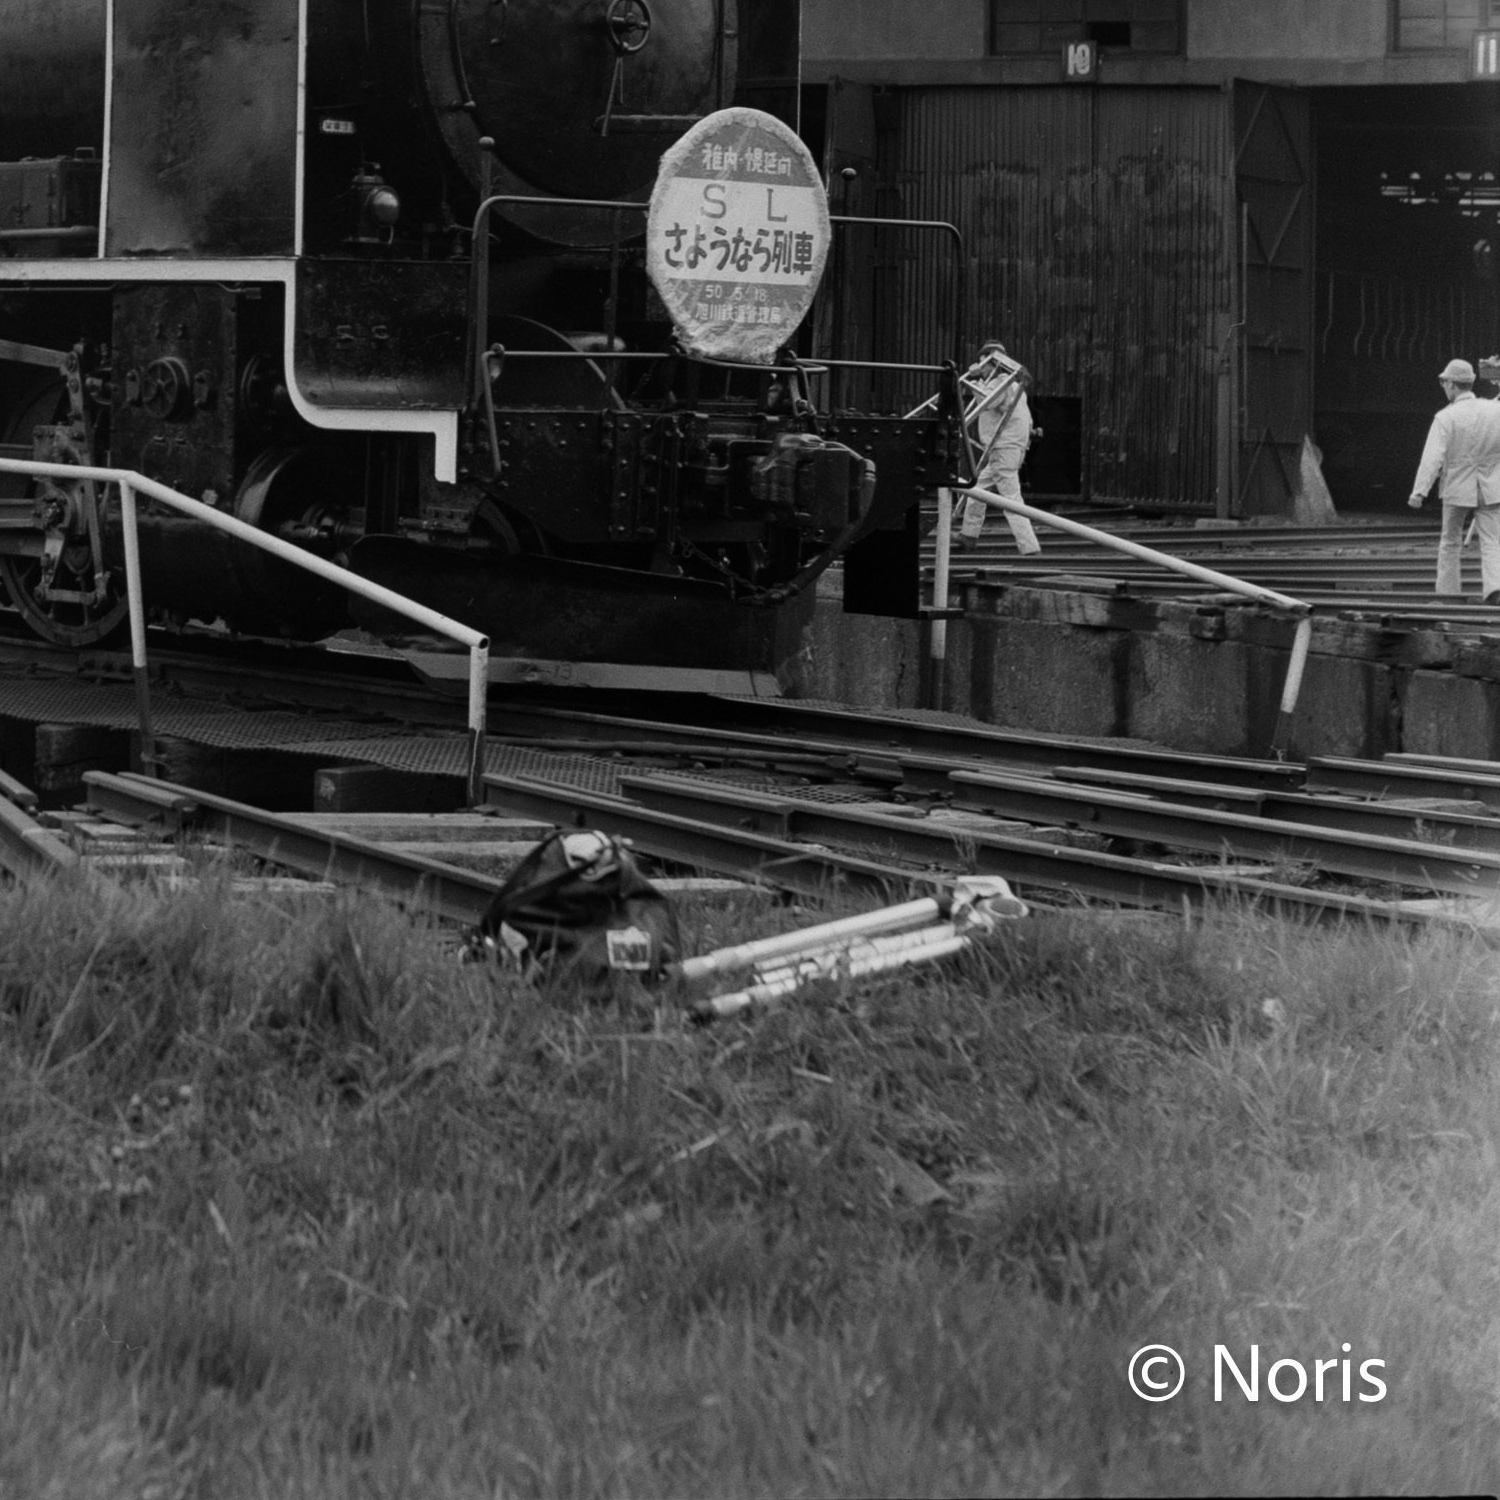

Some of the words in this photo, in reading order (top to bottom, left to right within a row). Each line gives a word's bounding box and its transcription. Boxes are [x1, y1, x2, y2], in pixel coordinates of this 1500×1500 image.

[1477, 38, 1497, 73] 11
[701, 183, 727, 219] S
[766, 188, 787, 222] L
[664, 222, 813, 275] さようなら列車
